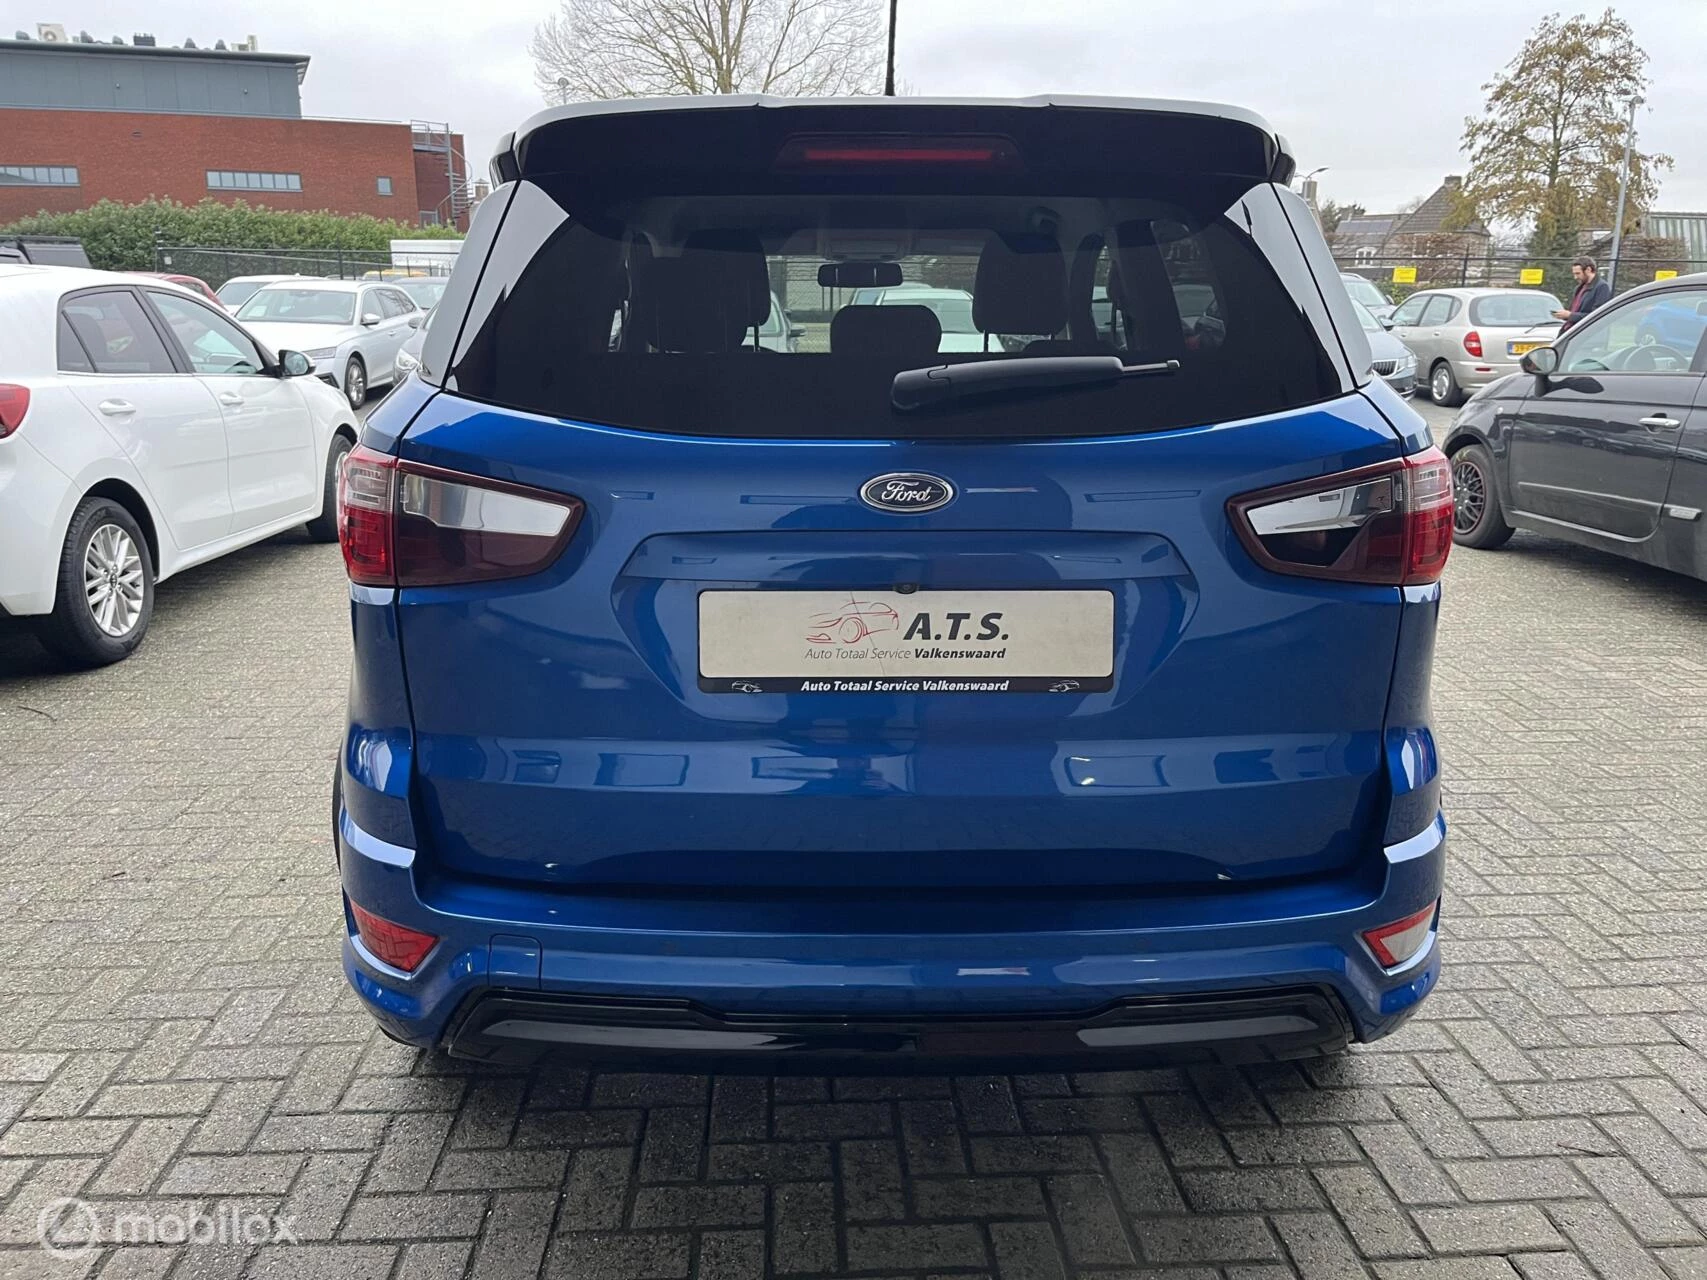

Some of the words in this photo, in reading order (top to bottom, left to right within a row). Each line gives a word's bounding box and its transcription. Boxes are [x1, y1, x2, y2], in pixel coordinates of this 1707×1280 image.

[881, 480, 931, 502] Ford
[903, 612, 1009, 641] A.T.S.
[804, 648, 832, 659] Auto
[835, 648, 868, 659] Totaal
[870, 647, 912, 659] Service
[914, 647, 1007, 659] Valkenswaard
[800, 680, 831, 692] Auto
[833, 680, 873, 692] Totaal
[874, 680, 920, 692] Service
[922, 680, 1010, 692] Valkenswaard
